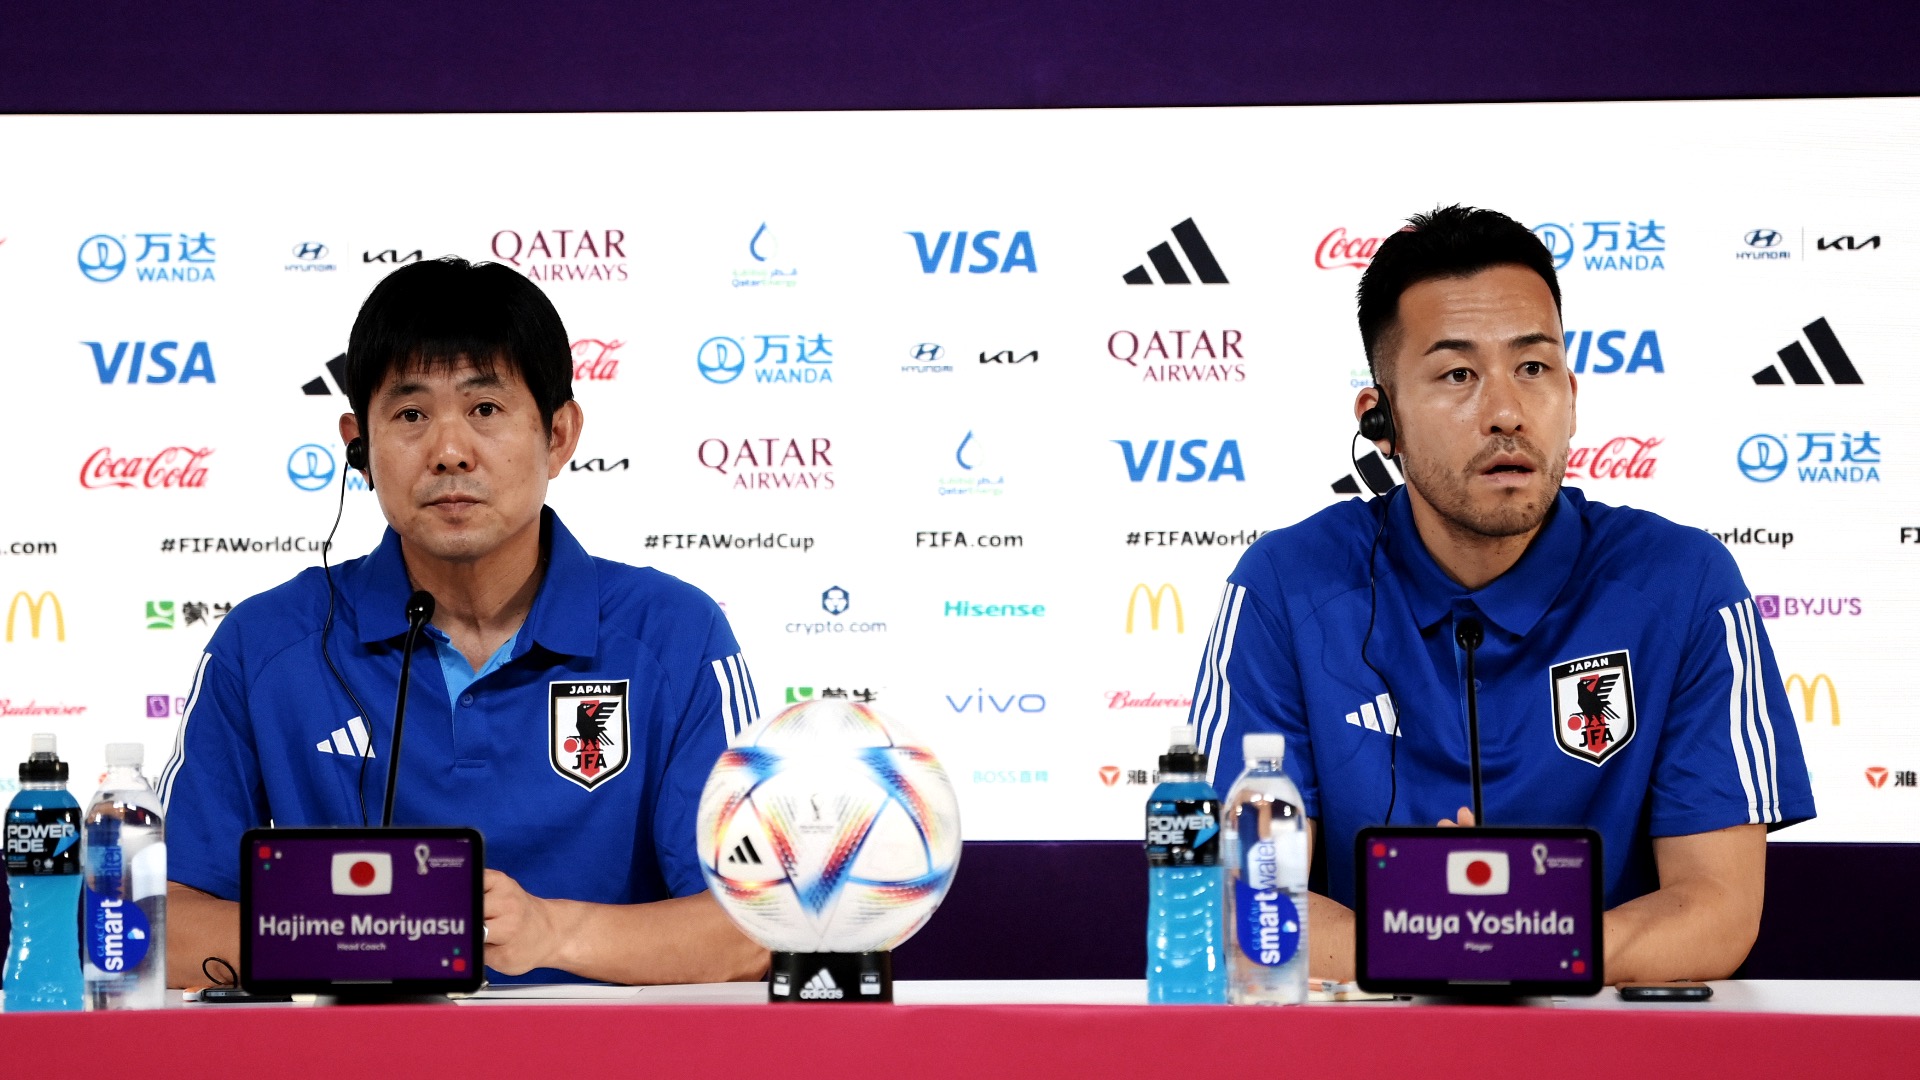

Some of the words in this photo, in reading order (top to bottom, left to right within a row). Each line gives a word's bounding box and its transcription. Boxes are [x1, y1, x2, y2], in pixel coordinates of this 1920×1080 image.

[490, 229, 627, 260] QATAR
[1582, 218, 1666, 253] 万达
[134, 231, 216, 264] 万达
[903, 230, 1039, 275] VISA
[1735, 251, 1791, 261] HYUNDAI
[284, 264, 337, 273] HYUNDAI
[1583, 254, 1665, 272] WANDA
[136, 266, 216, 283] WANDA
[528, 264, 629, 282] AIRWAYS
[753, 332, 833, 365] 万达
[1107, 329, 1244, 366] QATAR
[79, 340, 217, 386] VISA
[901, 365, 954, 373] HYUNDAI
[755, 367, 833, 385] WANDA
[1142, 364, 1246, 382] AIRWAYS
[697, 437, 833, 475] QATAR
[1796, 431, 1882, 464] 万达
[1109, 438, 1247, 483] VISA
[733, 472, 835, 490] AIRWAYS
[1797, 466, 1881, 483] WANDA
[0, 540, 58, 555] .com
[160, 535, 333, 555] #FIFAWorldCup
[644, 532, 815, 553] #FIFAWorldCup
[916, 530, 1024, 548] FIFA.com
[944, 600, 1046, 618] Hisense
[1785, 596, 1862, 617] BYJU'S
[785, 620, 887, 635] crypto.com
[1568, 657, 1609, 673] JAPAN
[569, 685, 612, 695] JAPAN
[945, 687, 1047, 713] vivo
[1579, 727, 1615, 747] JFA
[572, 753, 608, 770] JFA
[7, 824, 76, 839] POWER
[1149, 816, 1215, 831] POWER
[259, 914, 343, 942] Hajime
[350, 914, 465, 941] Moriyasu
[1383, 910, 1461, 939] Maya
[1466, 910, 1575, 935] Yoshida
[337, 942, 359, 951] Head
[361, 942, 386, 951] Coach
[800, 988, 844, 999] adidas
